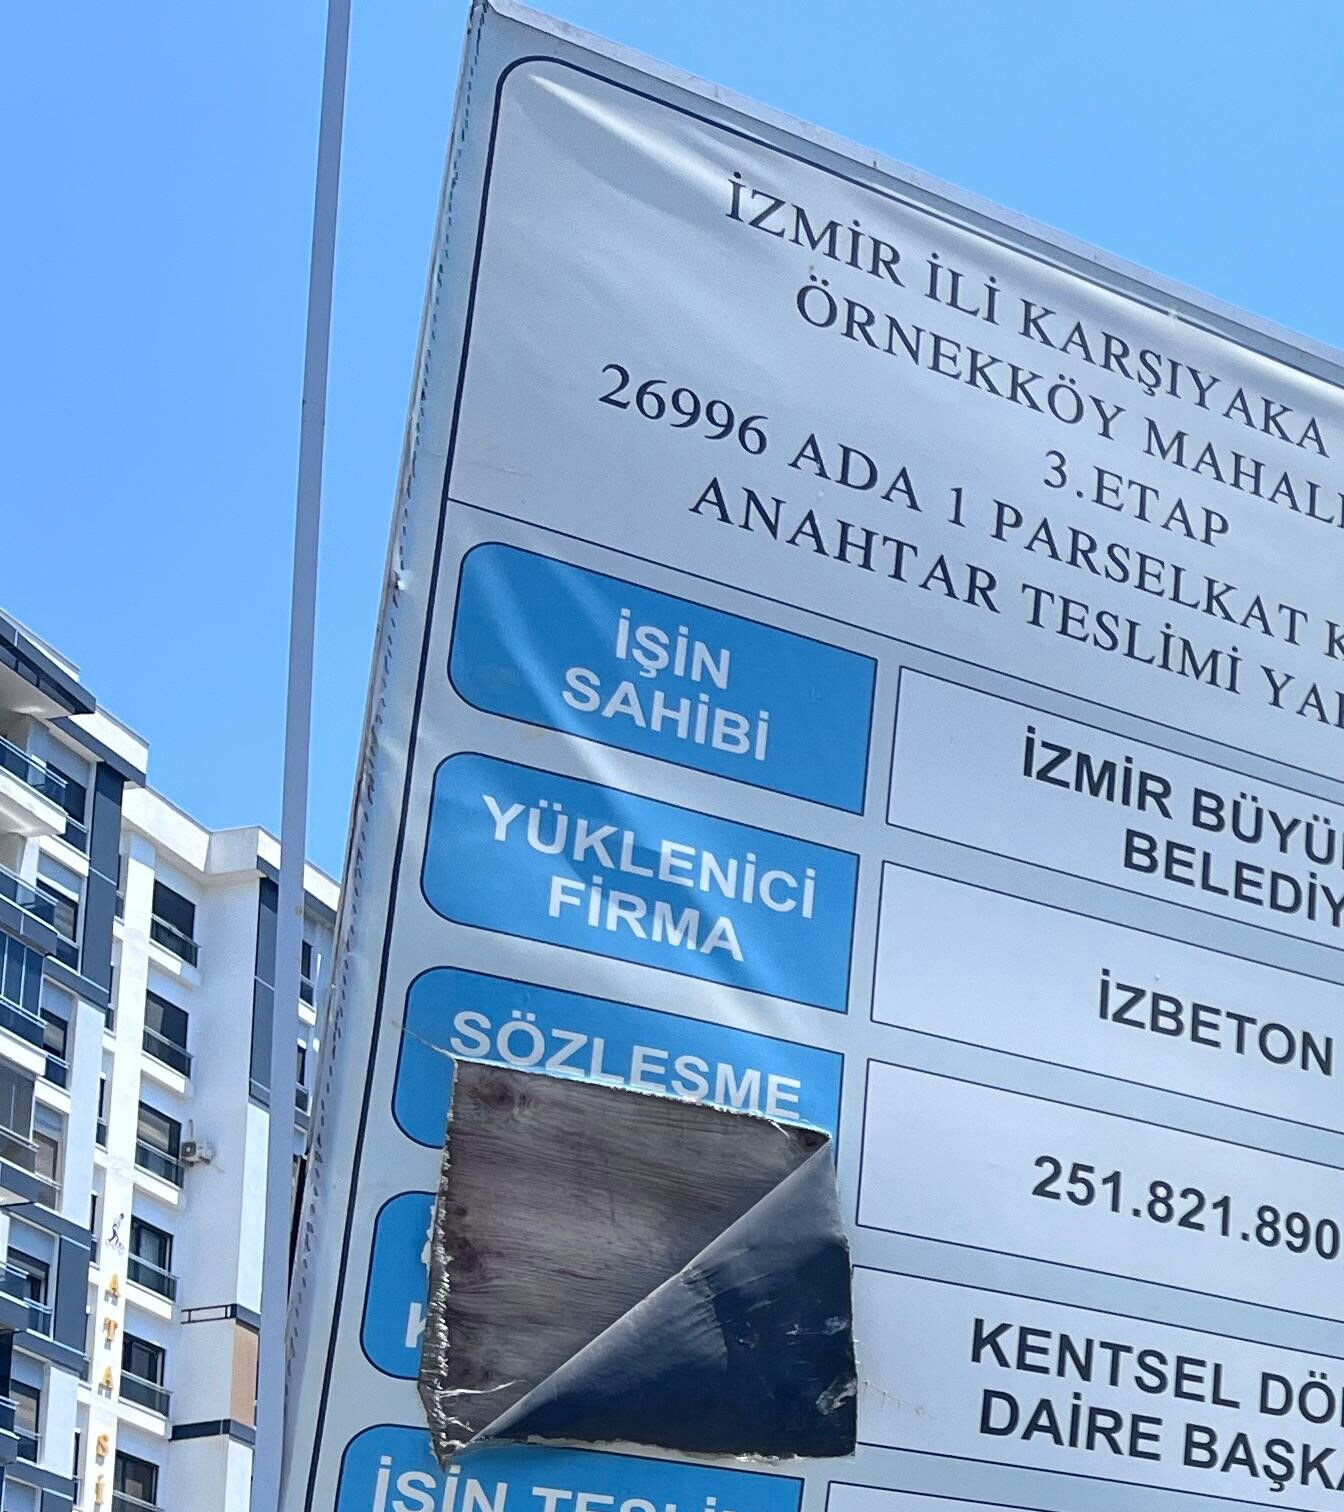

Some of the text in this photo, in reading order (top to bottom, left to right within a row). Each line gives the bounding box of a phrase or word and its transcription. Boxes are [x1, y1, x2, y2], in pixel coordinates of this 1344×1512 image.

[725, 171, 905, 288] İZMİR
[924, 253, 1000, 325] İLİ
[1018, 298, 1329, 458] KARŞIYAKA
[797, 283, 1126, 440] ÖRNEKKÖY
[599, 364, 768, 455] 26996
[788, 434, 922, 512] ADA
[948, 488, 966, 527] 1
[990, 499, 1308, 646] PARSELKAT
[1044, 450, 1228, 547] 3.ETAP
[689, 477, 1000, 613] ANAHTAR
[1022, 583, 1242, 695] TESLİMİ
[616, 608, 730, 689] İŞİN
[563, 668, 768, 760] SAHİBİ
[1024, 725, 1173, 820] İZMİR
[483, 795, 815, 918] YÜKLENİCİ
[549, 876, 744, 961] FİRMA
[1099, 968, 1333, 1076] İZBETON
[971, 1318, 1240, 1409] KENTSEL
[980, 1389, 1163, 1461] DAİRE
